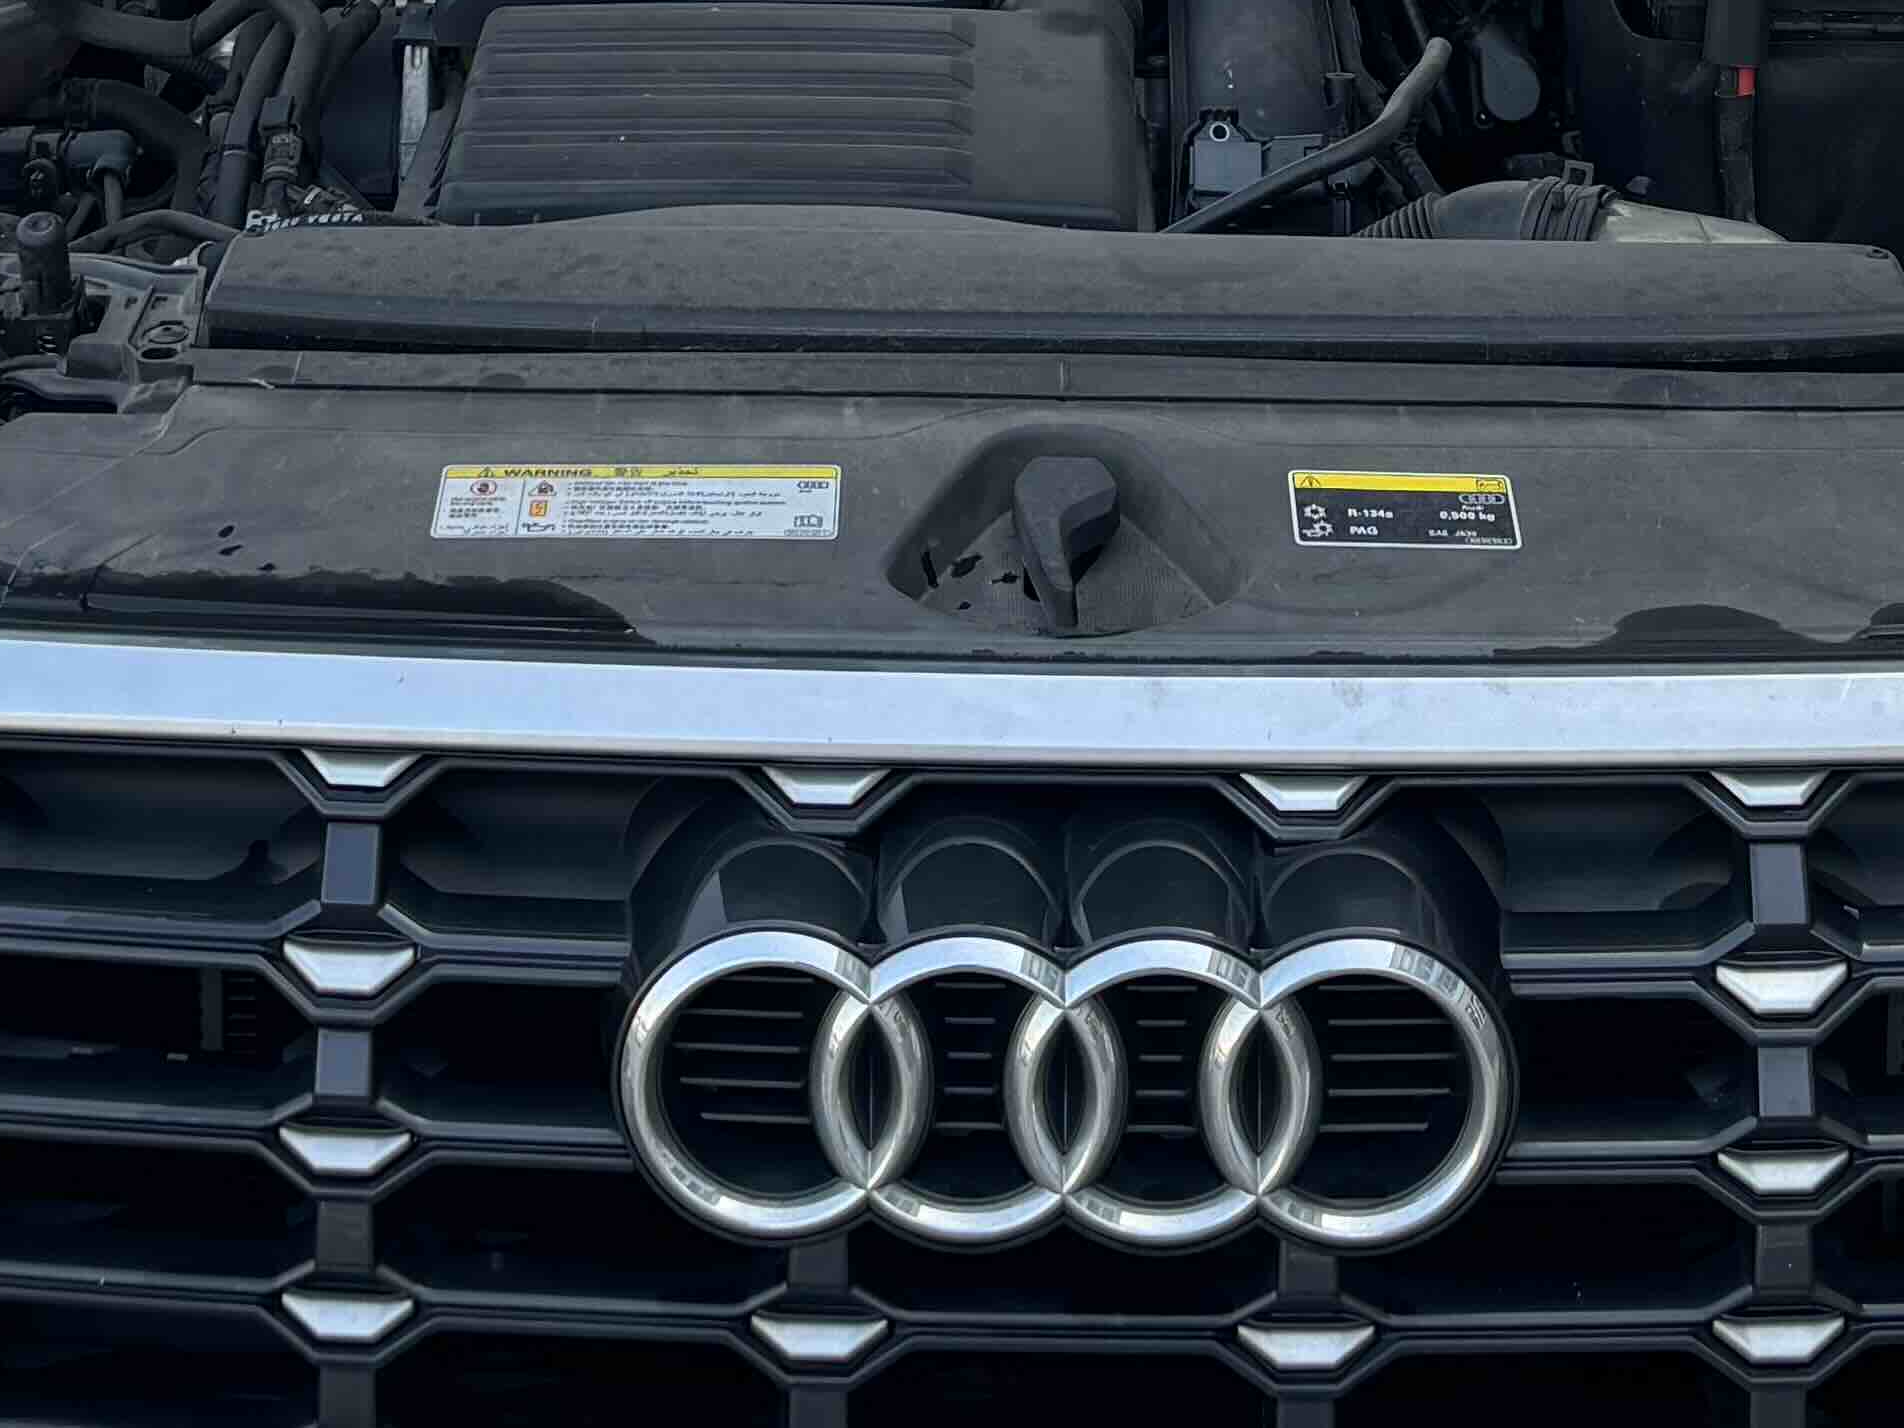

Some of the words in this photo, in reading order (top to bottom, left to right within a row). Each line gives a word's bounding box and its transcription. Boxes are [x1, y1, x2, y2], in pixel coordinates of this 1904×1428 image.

[503, 468, 593, 479] WARNING
[1347, 507, 1394, 519] R-134a
[1479, 511, 1496, 523] kg
[1349, 525, 1379, 536] PAG
